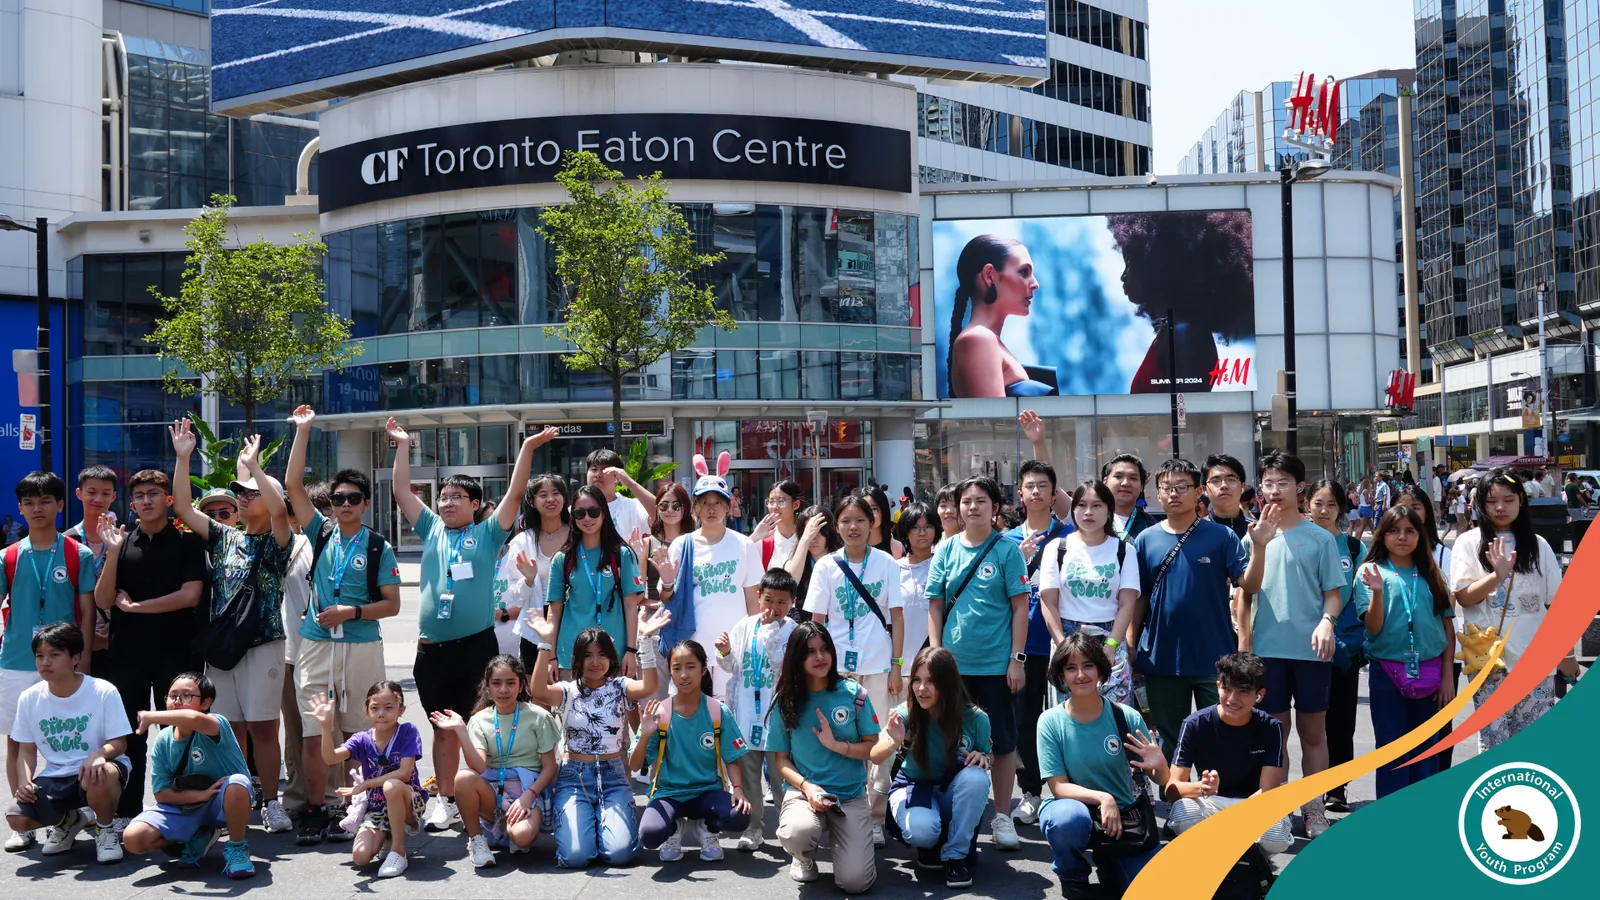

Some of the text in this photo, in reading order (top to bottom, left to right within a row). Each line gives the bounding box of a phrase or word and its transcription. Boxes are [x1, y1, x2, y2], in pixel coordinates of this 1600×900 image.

[361, 129, 847, 185] CF Toronto Eaton Centre
[1209, 357, 1251, 386] H&M
[39, 714, 90, 737] STUDY
